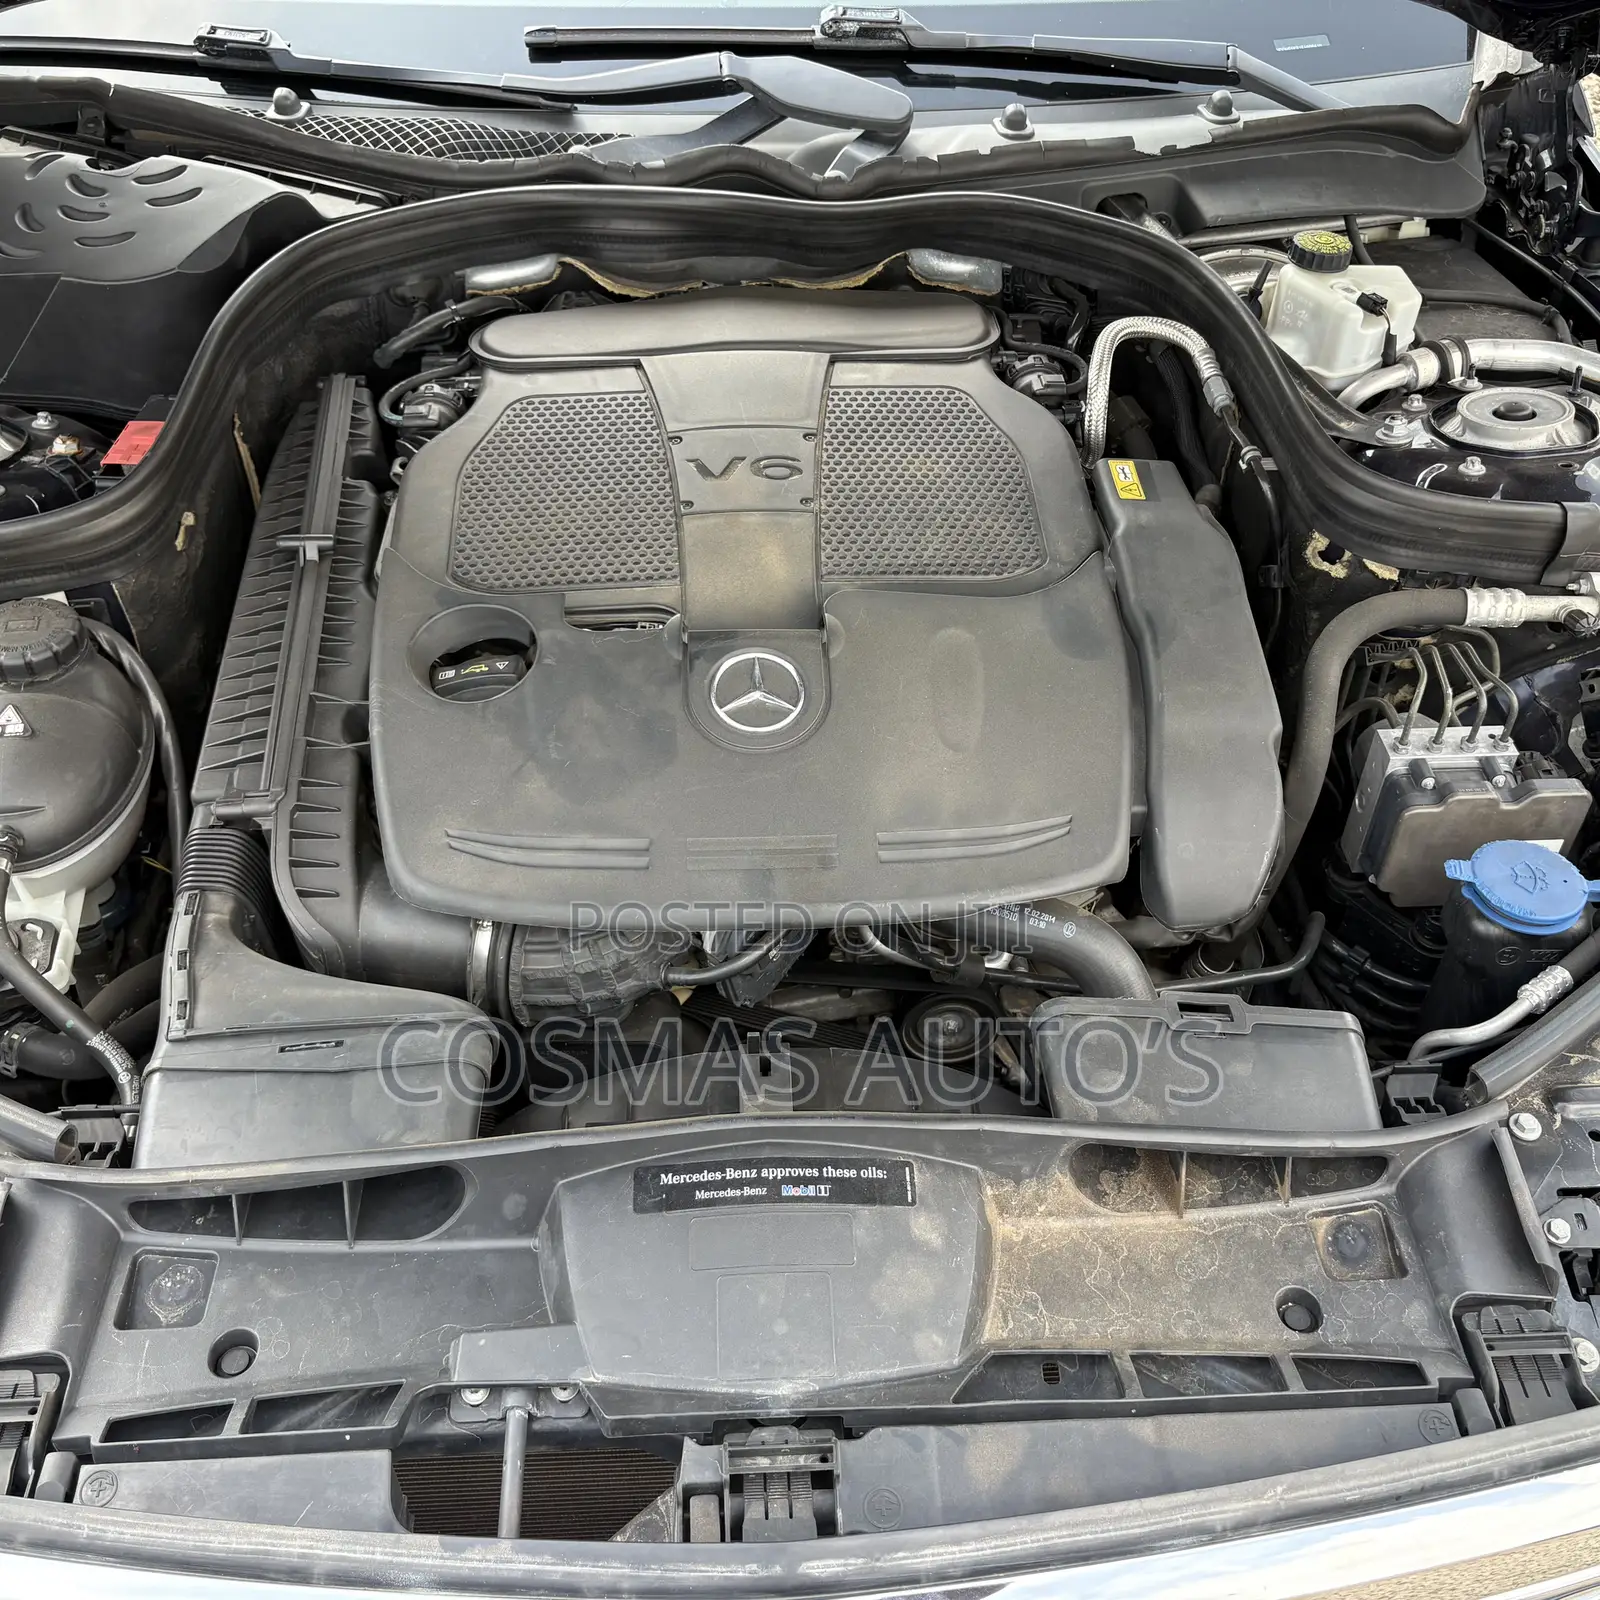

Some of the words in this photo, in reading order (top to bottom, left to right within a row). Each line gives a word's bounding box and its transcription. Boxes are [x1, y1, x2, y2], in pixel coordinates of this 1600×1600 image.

[684, 455, 804, 482] V6
[659, 1167, 758, 1186] Mercedes-Benz
[761, 1167, 820, 1180] approves
[822, 1166, 858, 1178] these
[860, 1167, 888, 1179] oils:
[695, 1186, 768, 1200] Mercedes-Benz
[781, 1184, 816, 1197] Mobil
